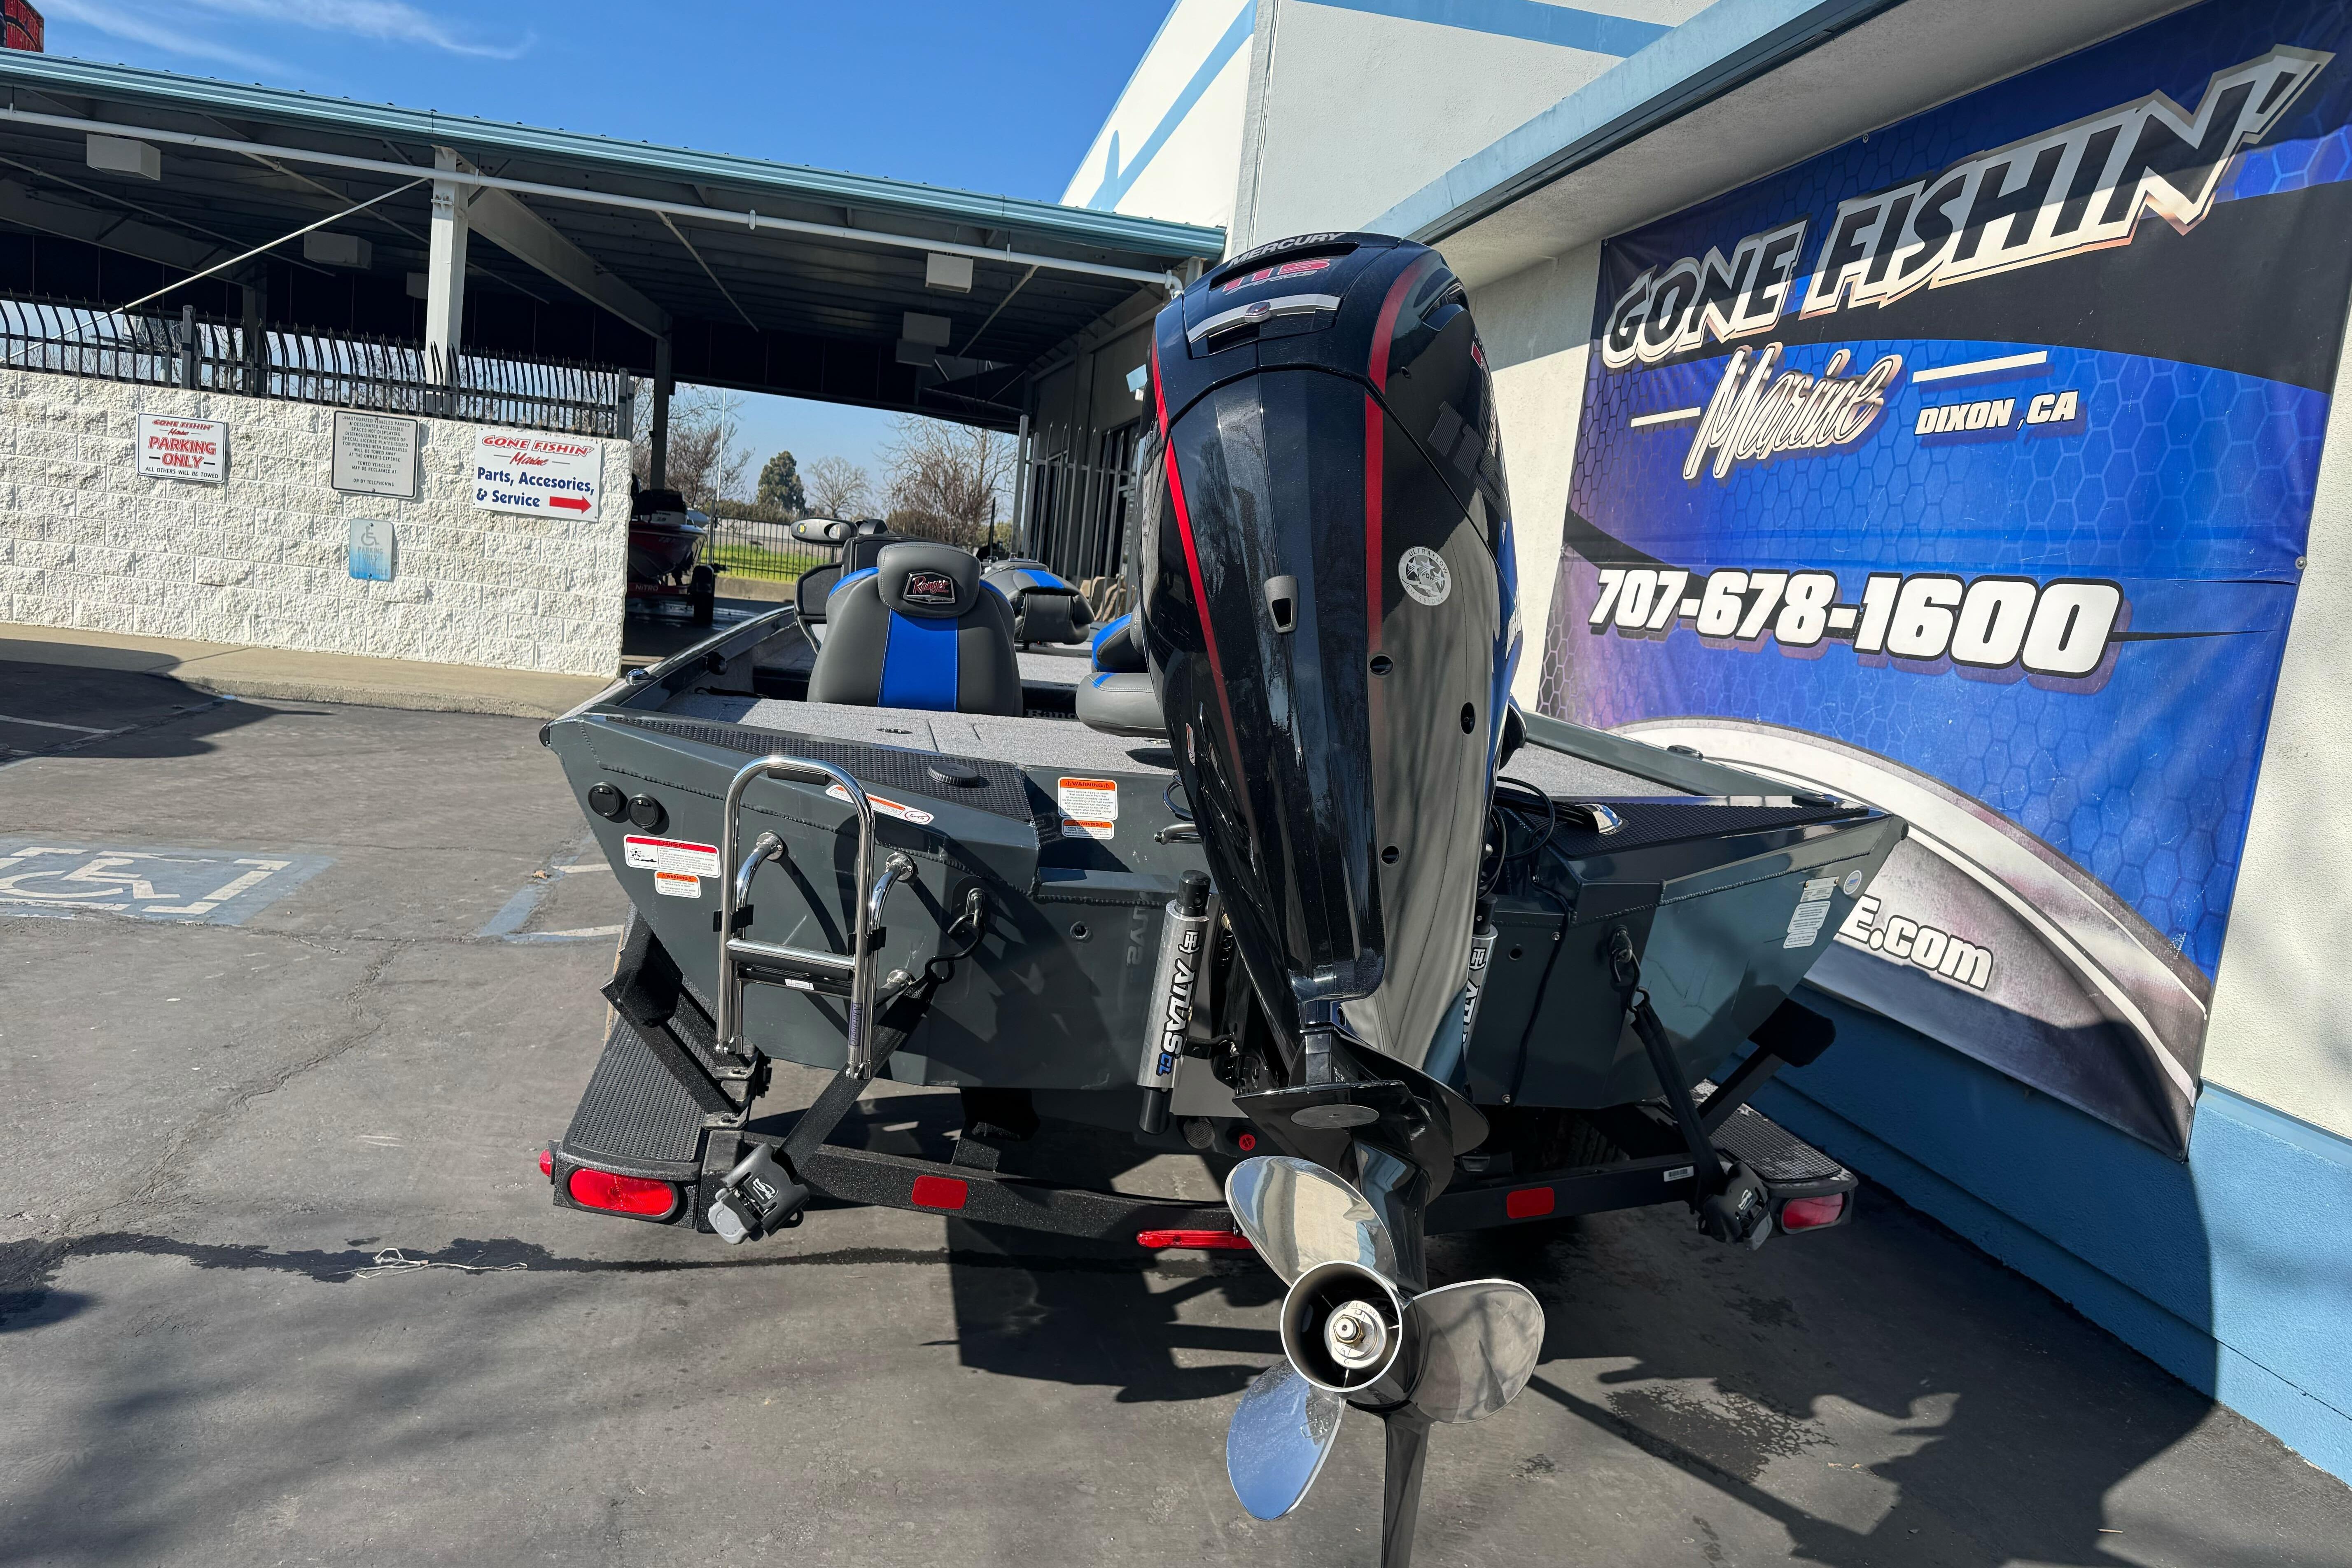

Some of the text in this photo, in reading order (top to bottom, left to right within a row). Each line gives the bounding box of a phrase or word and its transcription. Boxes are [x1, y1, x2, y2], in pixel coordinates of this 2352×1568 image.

[1603, 44, 2337, 368] GONE FISHIN'
[1226, 233, 1346, 268] MERCURY
[1223, 259, 1330, 292] 115
[1683, 342, 1902, 479] Marine
[1914, 397, 2016, 435] DIXON
[148, 436, 216, 455] PARKING
[482, 435, 594, 457] GONE FISHIN'
[162, 453, 204, 469] ONLY
[509, 452, 548, 466] Marine
[478, 467, 594, 495] Parts, Accesories,
[476, 488, 540, 507] & Service
[1436, 557, 1448, 573] LOW
[912, 576, 949, 594] Ranger
[1588, 565, 2121, 679] 707-678-1600
[1161, 958, 1195, 1057] ATLAS
[1157, 1052, 1174, 1075] CL
